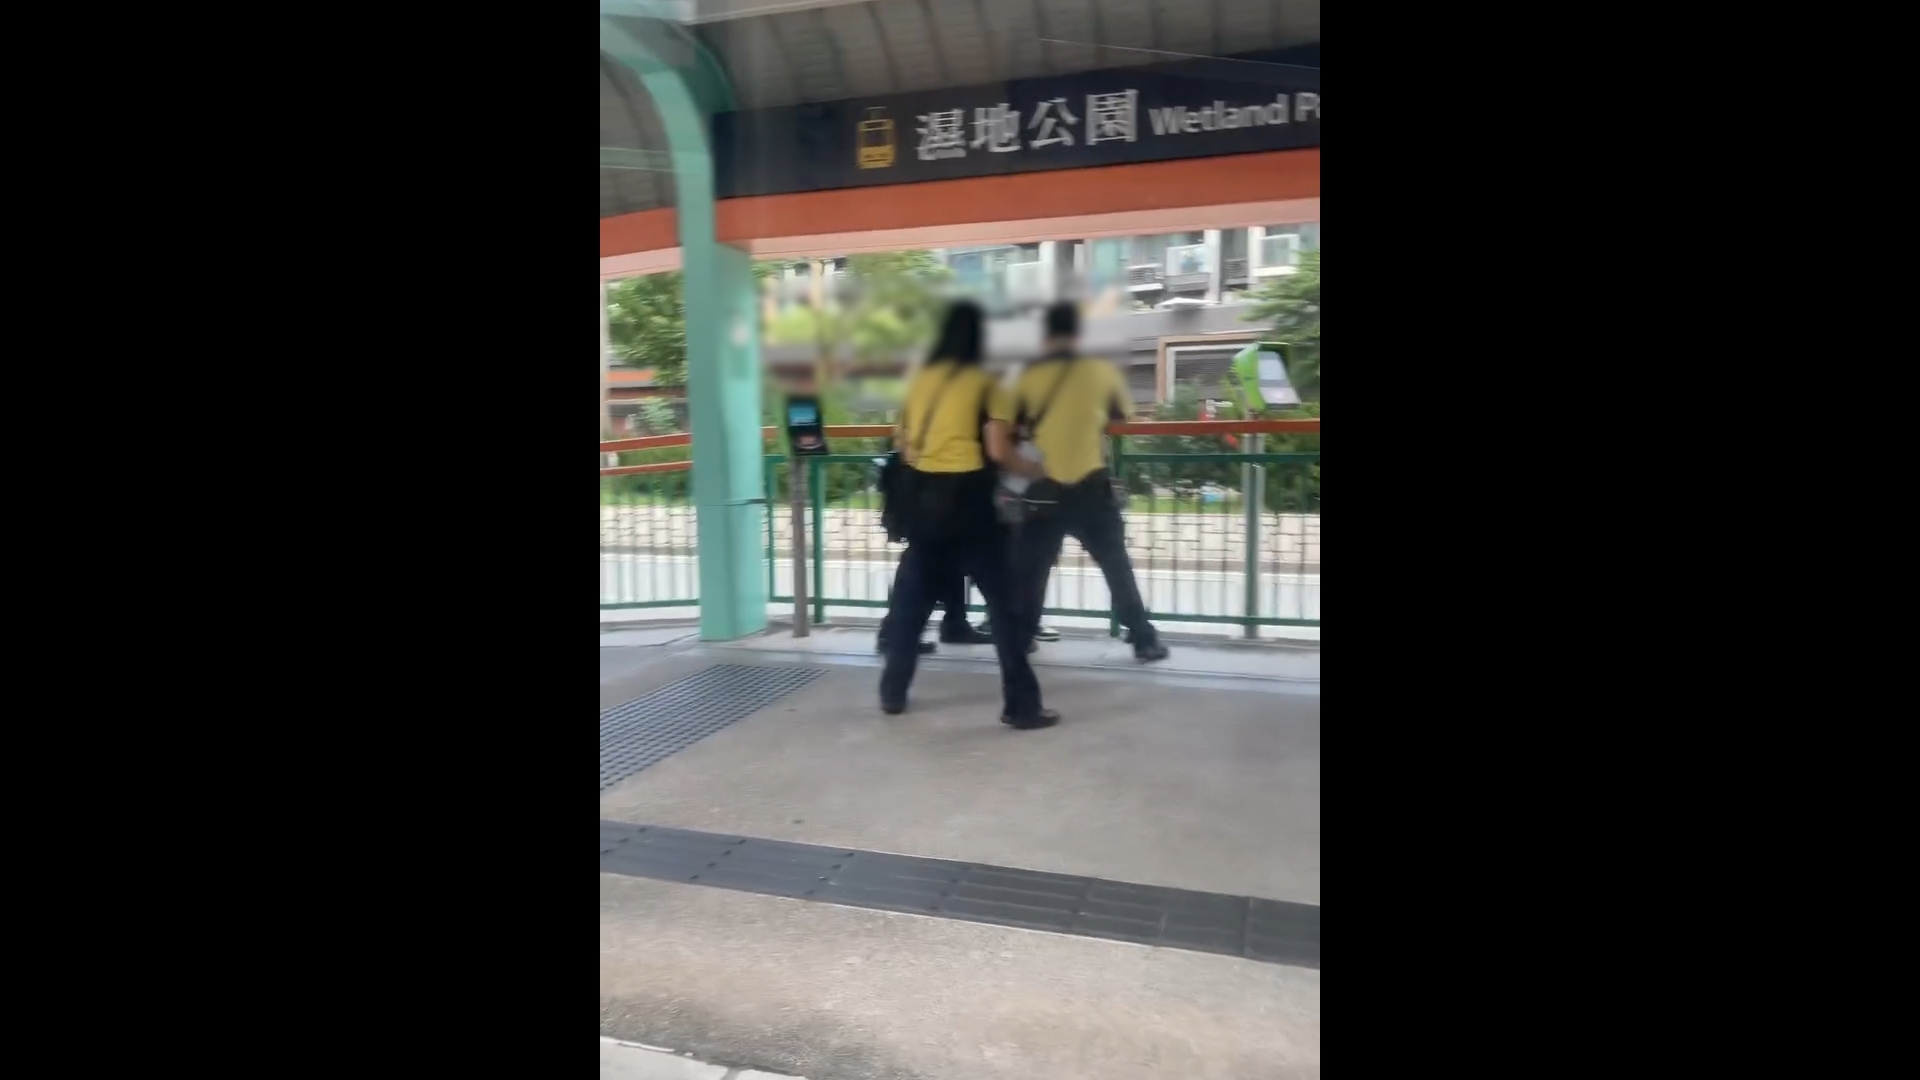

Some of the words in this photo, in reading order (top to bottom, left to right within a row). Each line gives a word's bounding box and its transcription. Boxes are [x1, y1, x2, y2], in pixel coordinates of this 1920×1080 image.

[915, 88, 1139, 160] 濕地公園
[1148, 93, 1290, 136] Wetland
[1294, 91, 1320, 122] P
